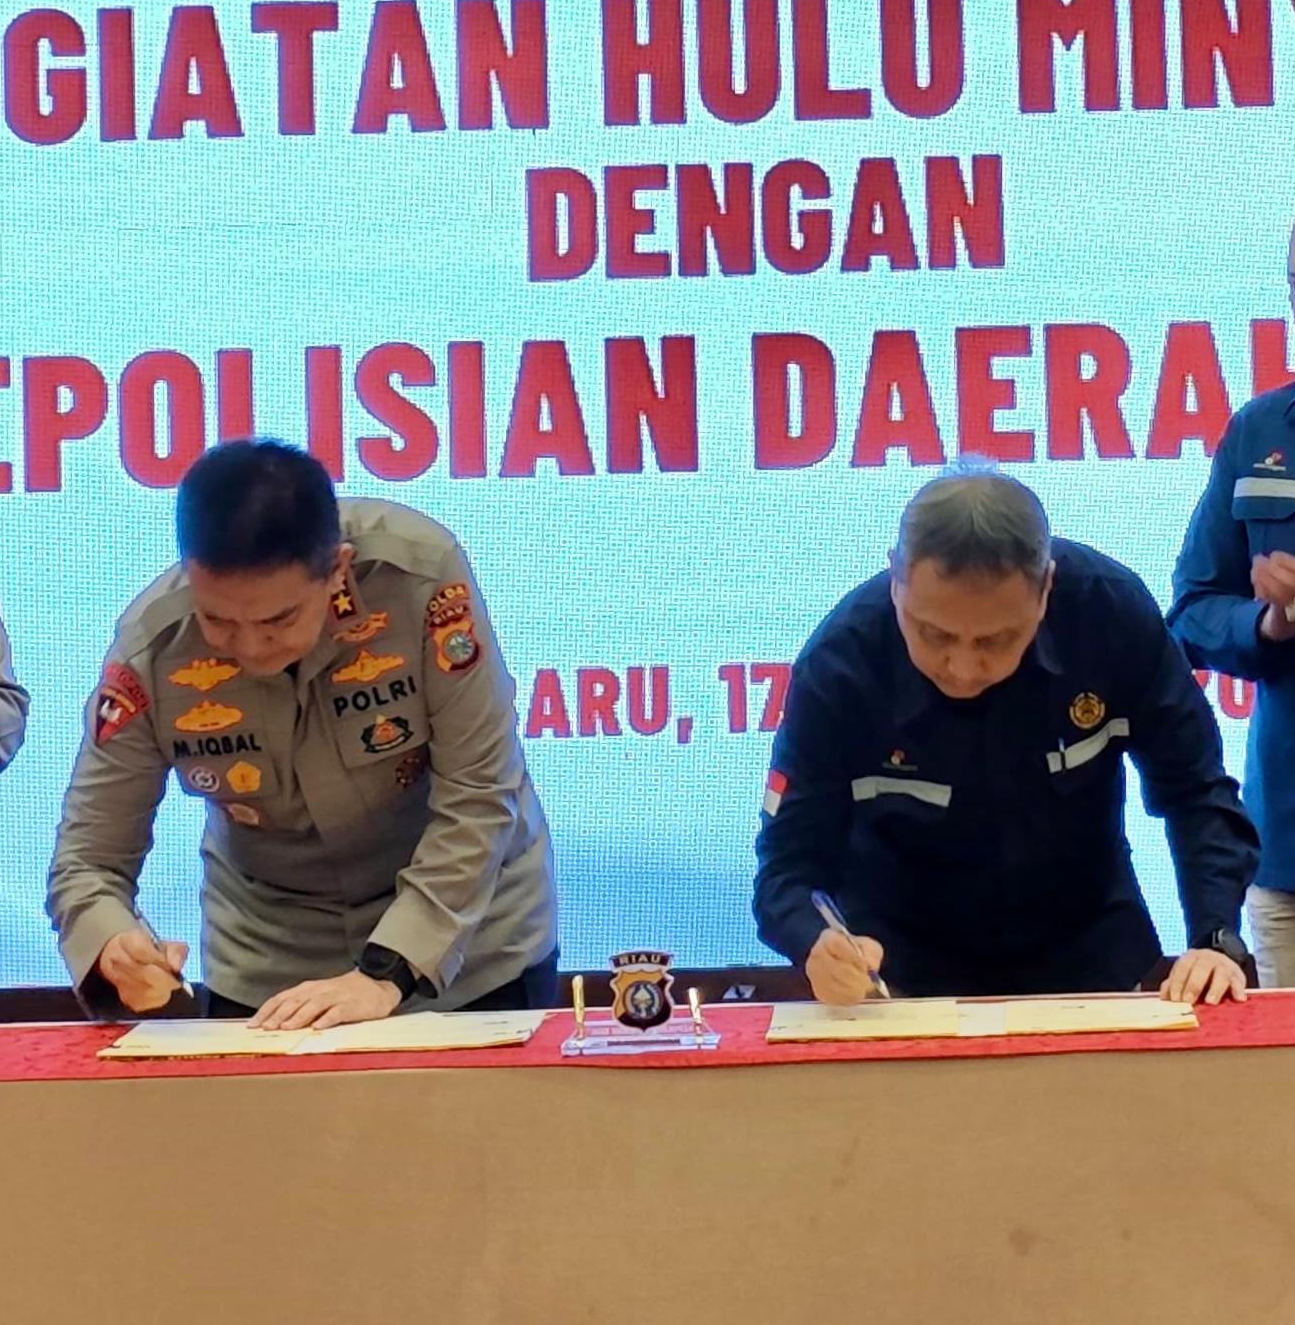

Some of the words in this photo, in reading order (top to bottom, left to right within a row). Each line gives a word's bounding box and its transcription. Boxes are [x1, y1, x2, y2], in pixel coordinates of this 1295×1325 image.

[530, 155, 1003, 278] DENGAN
[428, 584, 466, 613] OLDA
[332, 675, 419, 718] POLRI
[172, 732, 262, 760] M.IQBAL
[618, 953, 662, 966] RIAU
